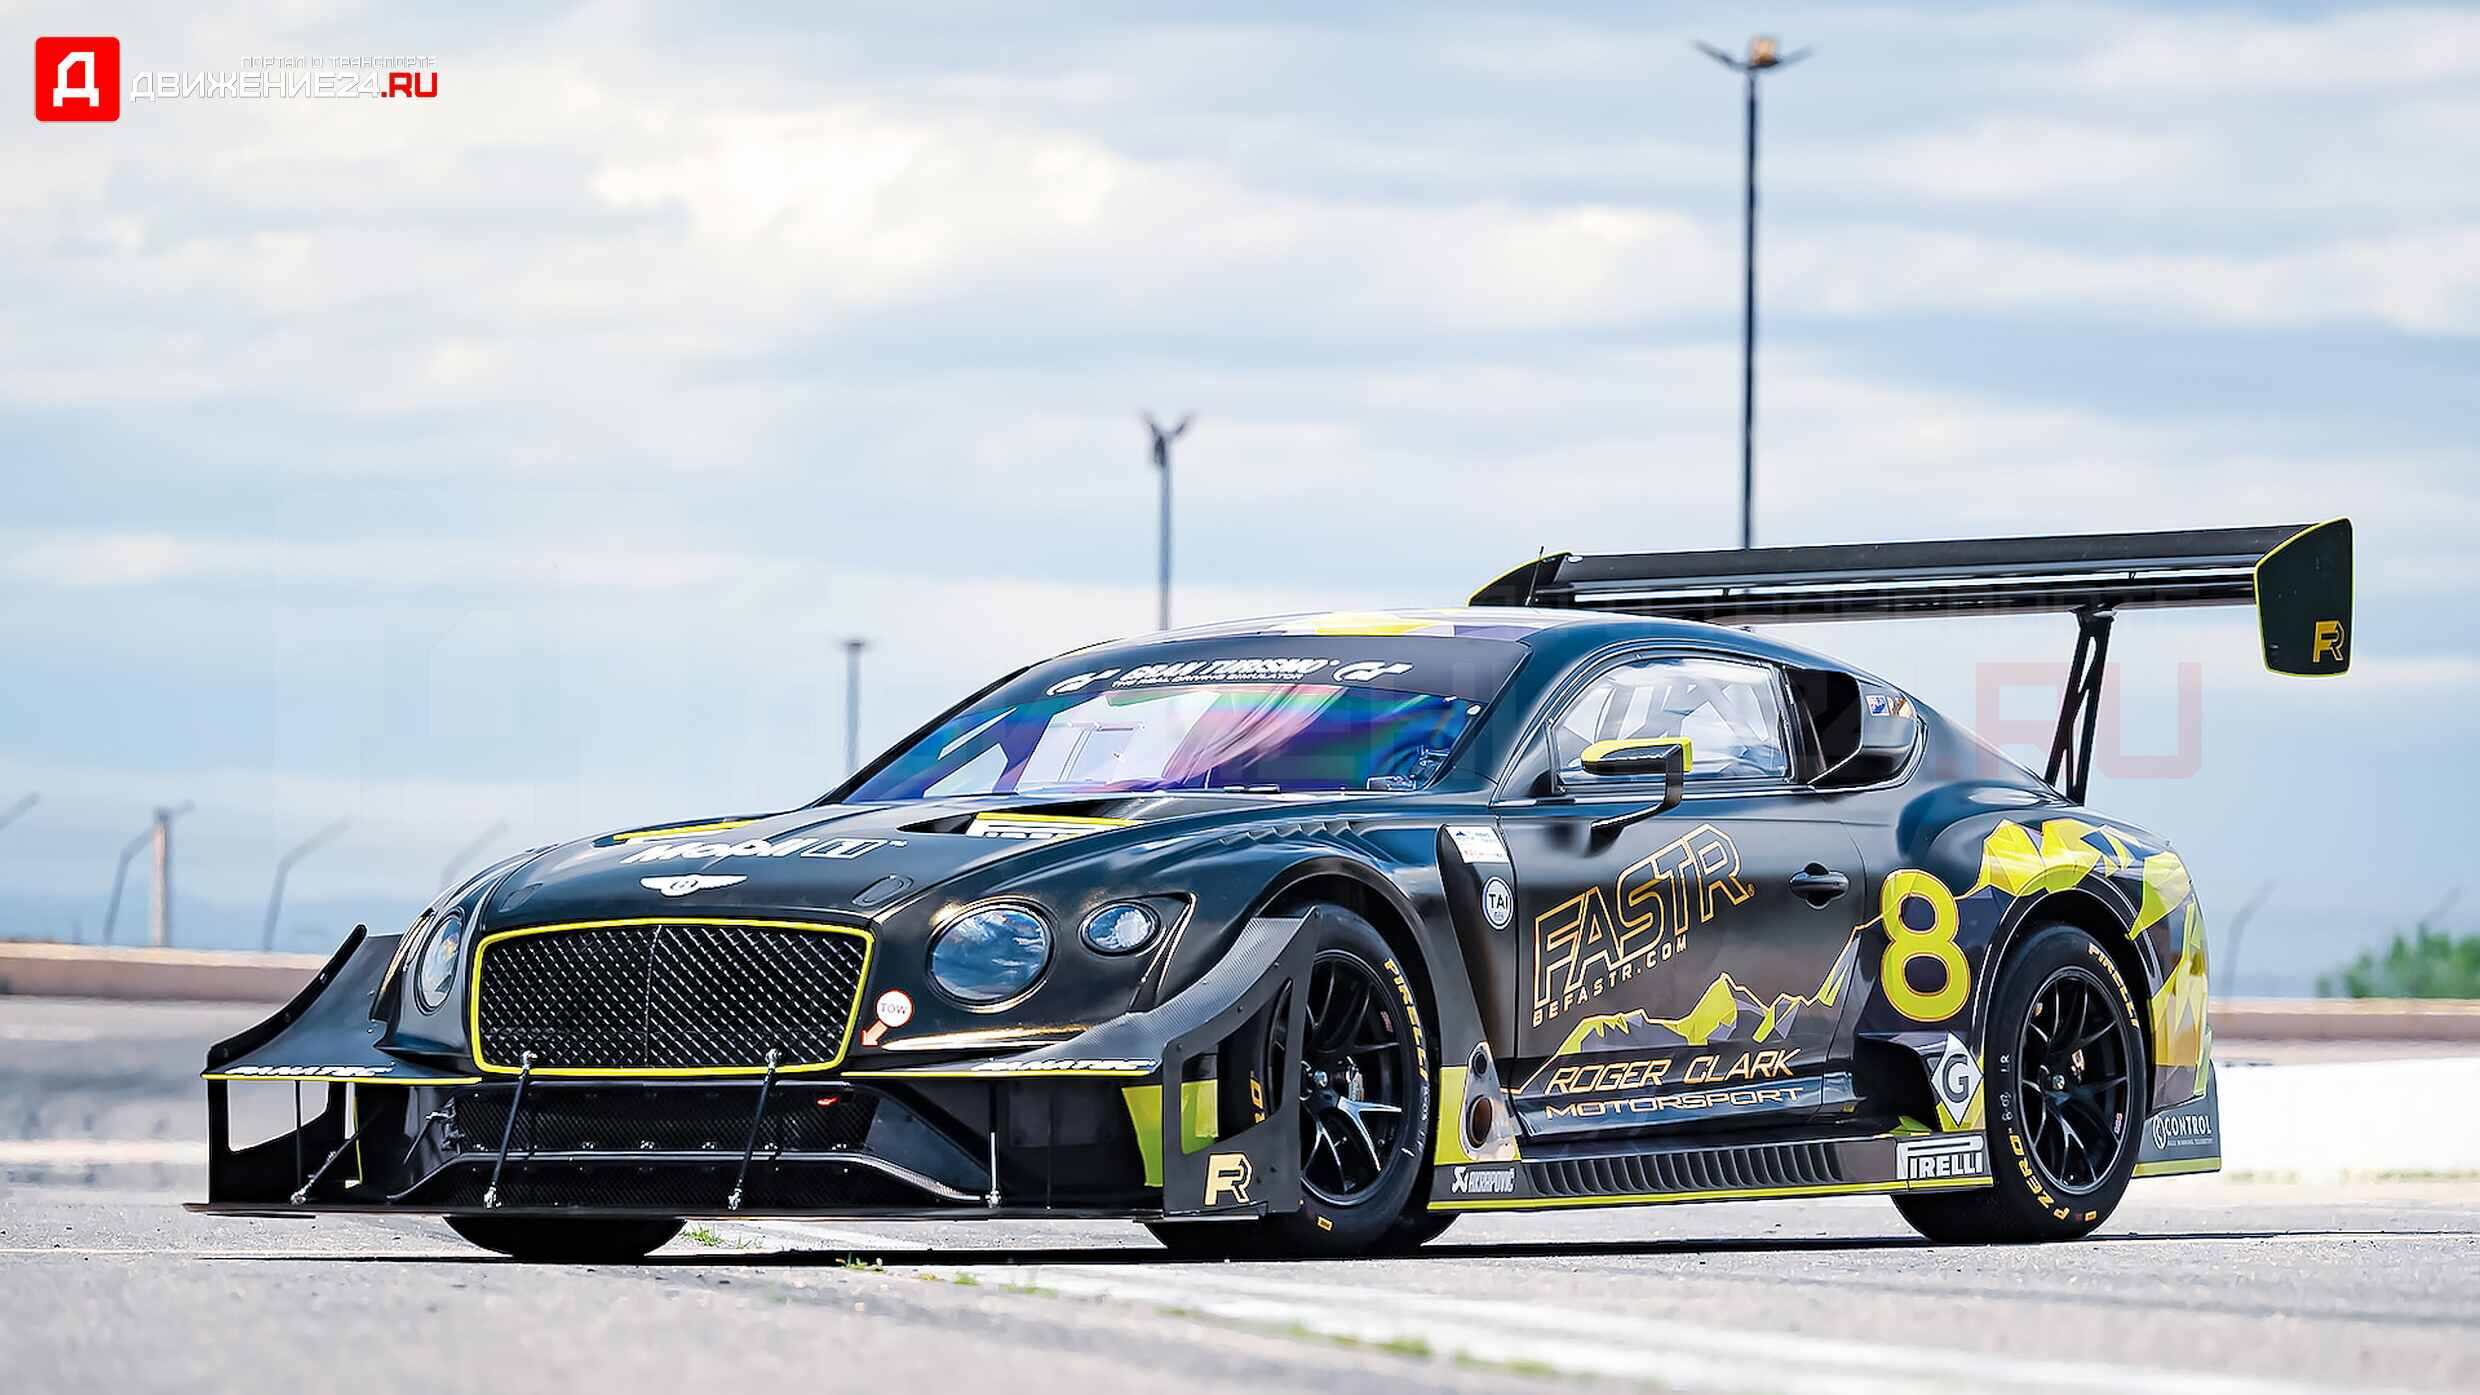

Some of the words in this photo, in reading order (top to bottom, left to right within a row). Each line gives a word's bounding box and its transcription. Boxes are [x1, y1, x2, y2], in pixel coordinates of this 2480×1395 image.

[1880, 868, 1972, 1023] 8
[1532, 936, 1688, 1028] BEFASTR.COM
[2087, 942, 2141, 1029] PIRELLI
[880, 1002, 908, 1014] TOW
[1543, 1058, 1673, 1096] ROGER
[1683, 1047, 1802, 1085] CLARK
[1941, 1052, 1970, 1104] G
[1545, 1086, 1805, 1121] MOTORSPORT
[2165, 1115, 2213, 1137] CONTROL
[1896, 1134, 1985, 1181] PIRELLI
